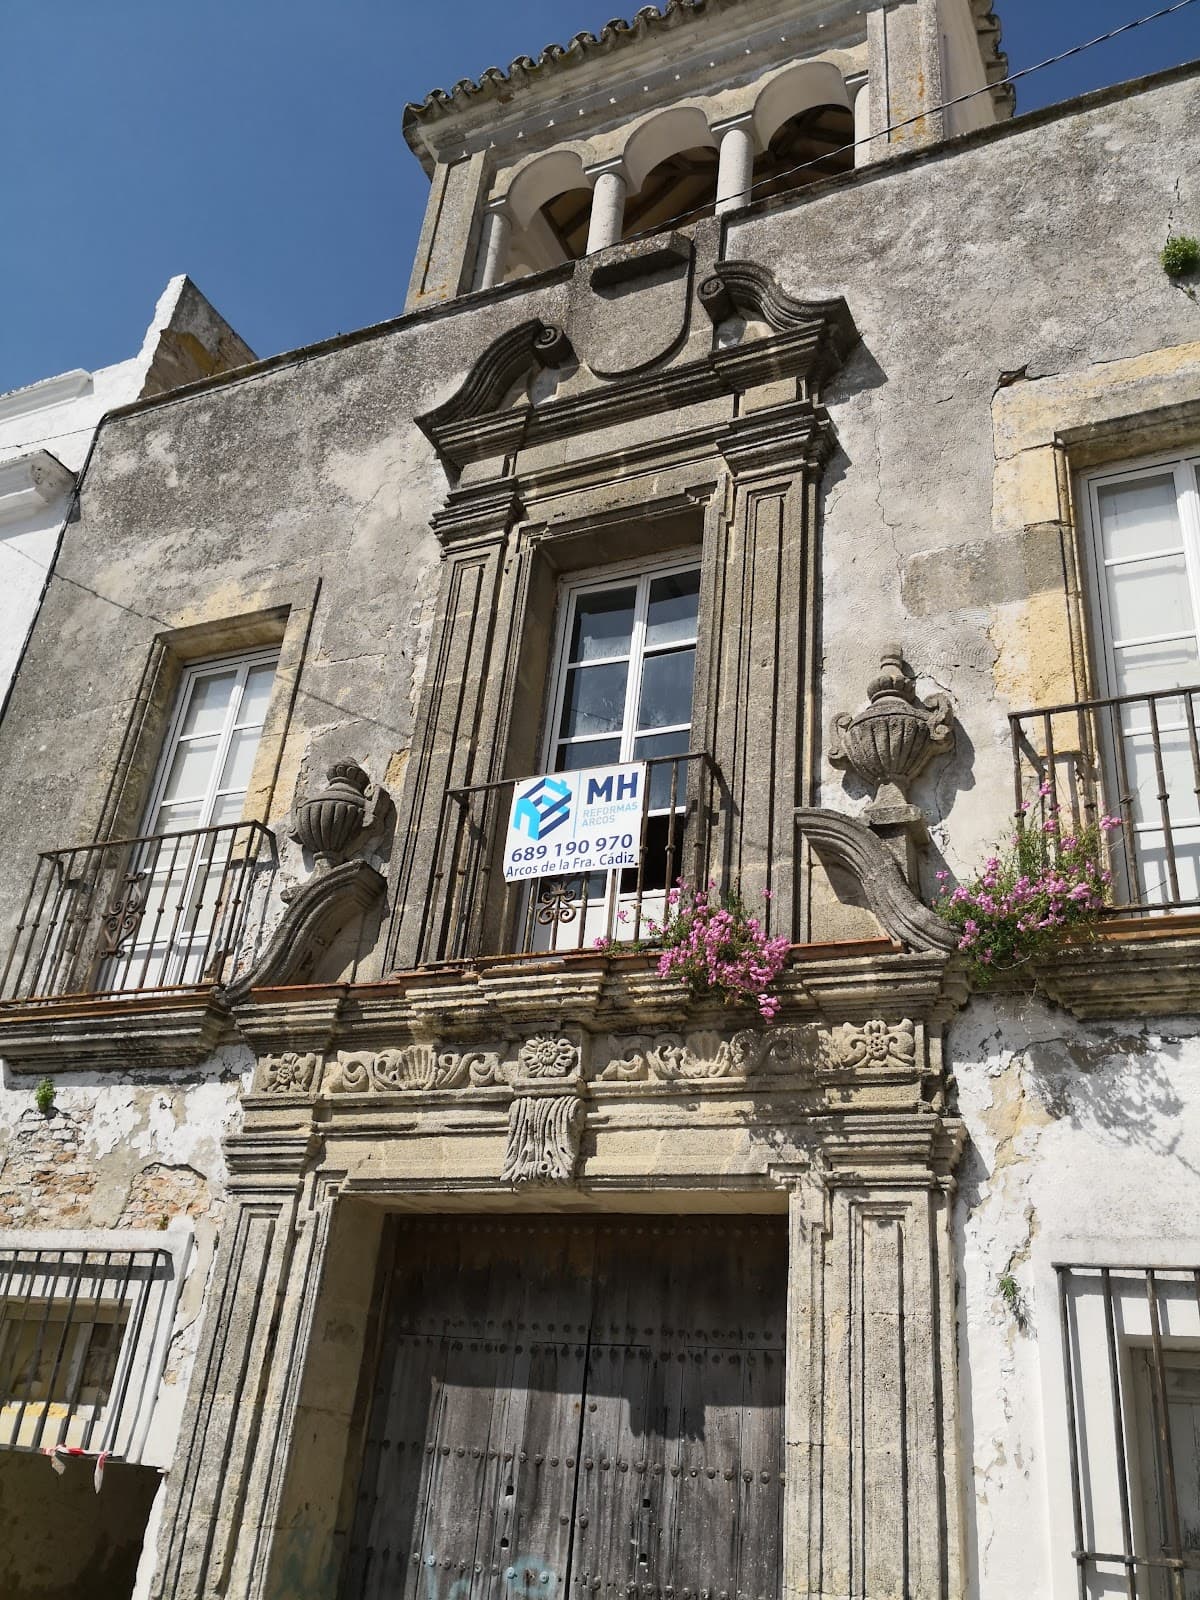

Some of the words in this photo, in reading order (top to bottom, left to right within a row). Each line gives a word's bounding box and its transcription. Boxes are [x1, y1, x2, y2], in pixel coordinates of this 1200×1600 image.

[587, 772, 638, 804] MH
[582, 815, 615, 827] ARCOS
[583, 802, 638, 818] REFORMAS
[511, 845, 547, 862] 689
[554, 840, 589, 857] 190
[595, 833, 633, 852] 970
[506, 865, 538, 877] Arcos
[541, 861, 556, 873] de
[560, 859, 569, 871] la
[573, 857, 596, 869] Fra.
[599, 851, 635, 866] Cádiz
